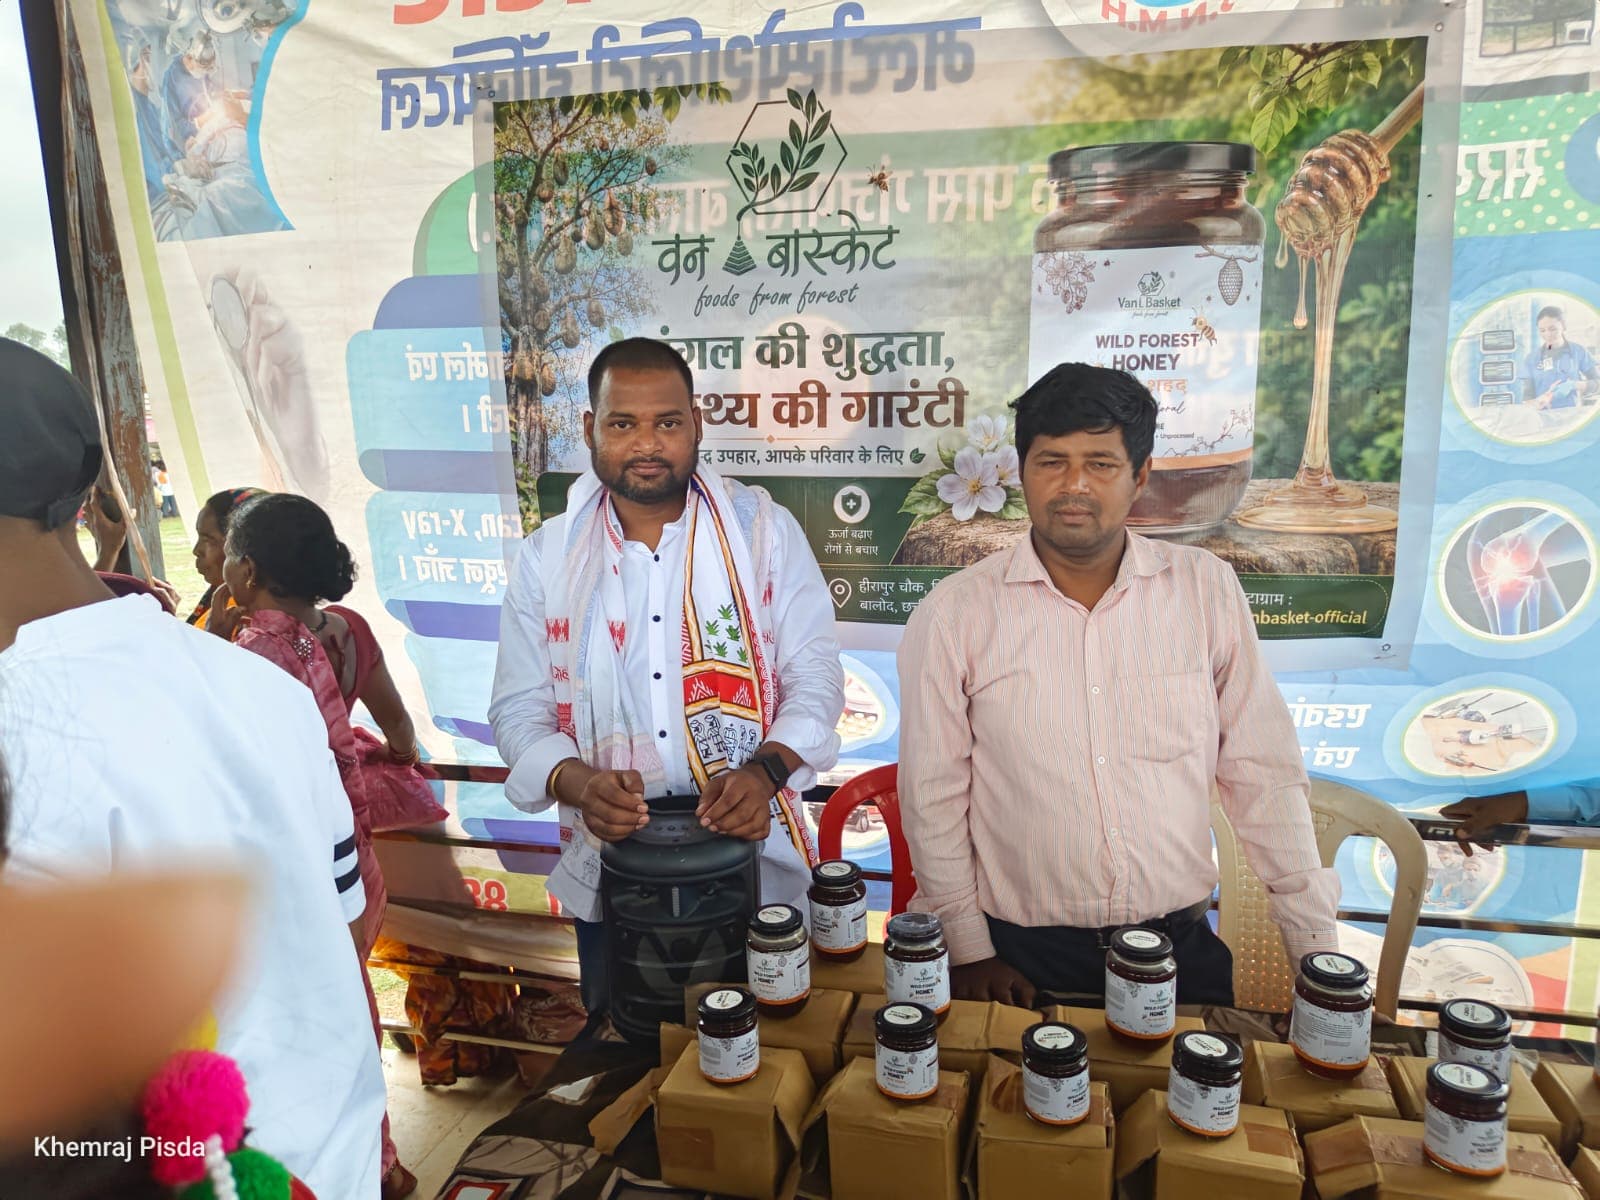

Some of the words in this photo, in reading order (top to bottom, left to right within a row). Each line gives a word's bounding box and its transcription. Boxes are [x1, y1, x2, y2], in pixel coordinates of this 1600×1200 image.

[652, 233, 715, 285] वन
[766, 210, 900, 276] बास्केट
[694, 284, 739, 317] foods
[749, 282, 792, 315] from
[796, 280, 860, 314] forest
[1146, 295, 1181, 307] Basket
[1096, 335, 1134, 348] WILD
[1139, 333, 1199, 348] FOREST
[755, 322, 810, 369] की
[822, 331, 955, 381] शुद्धता,
[1112, 353, 1180, 371] HONEY
[772, 379, 830, 428] की
[841, 377, 968, 430] गारंटी
[717, 449, 760, 466] उपहार,
[765, 446, 805, 464] आपके
[810, 446, 854, 464] परिवार
[858, 446, 872, 464] के
[876, 445, 903, 464] लिए
[828, 526, 848, 539] ऊर्जा
[845, 543, 852, 555] से
[856, 546, 878, 555] बचाए
[858, 577, 895, 596] हीरापुर
[899, 578, 928, 595] चौक,
[860, 597, 898, 614] बालोद,
